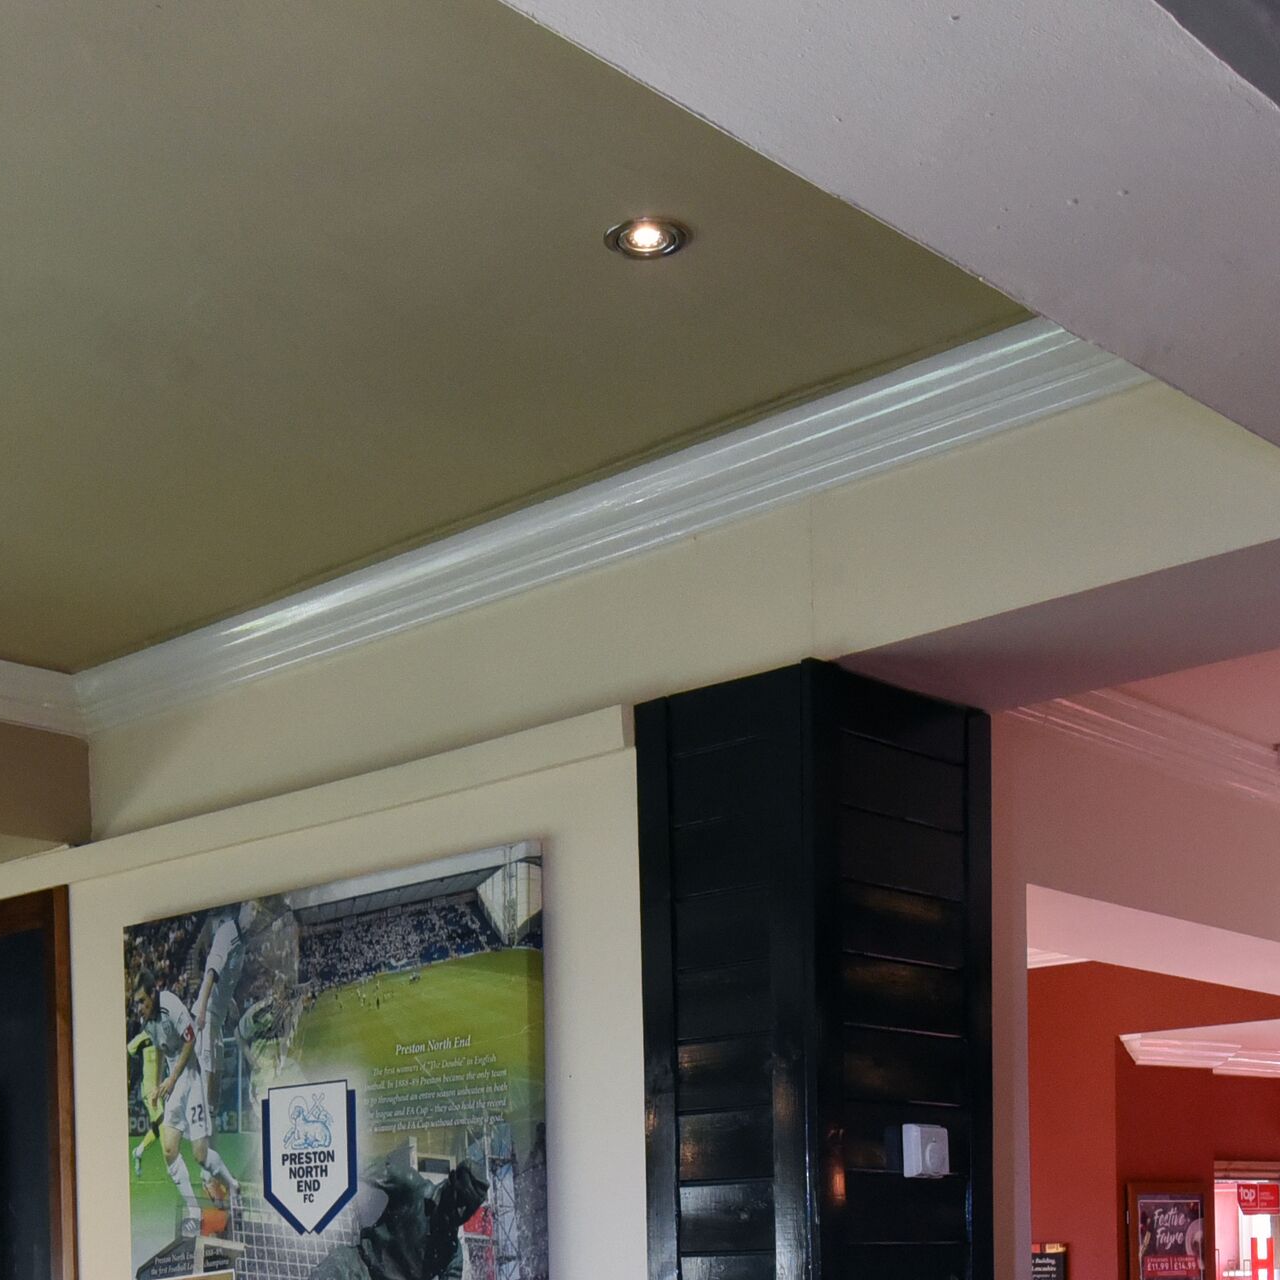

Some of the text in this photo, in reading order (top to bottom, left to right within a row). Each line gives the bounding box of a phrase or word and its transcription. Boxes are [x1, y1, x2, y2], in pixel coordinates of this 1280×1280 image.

[395, 1035, 471, 1055] Preston North End
[191, 1103, 205, 1124] 22
[281, 1150, 335, 1166] PRESTON
[289, 1165, 328, 1179] NORTH
[297, 1179, 320, 1193] END
[303, 1193, 315, 1203] FC
[1153, 1207, 1188, 1228] Festive
[1156, 1227, 1185, 1250] Fayre
[1147, 1261, 1197, 1272] £11.99 £14.99
